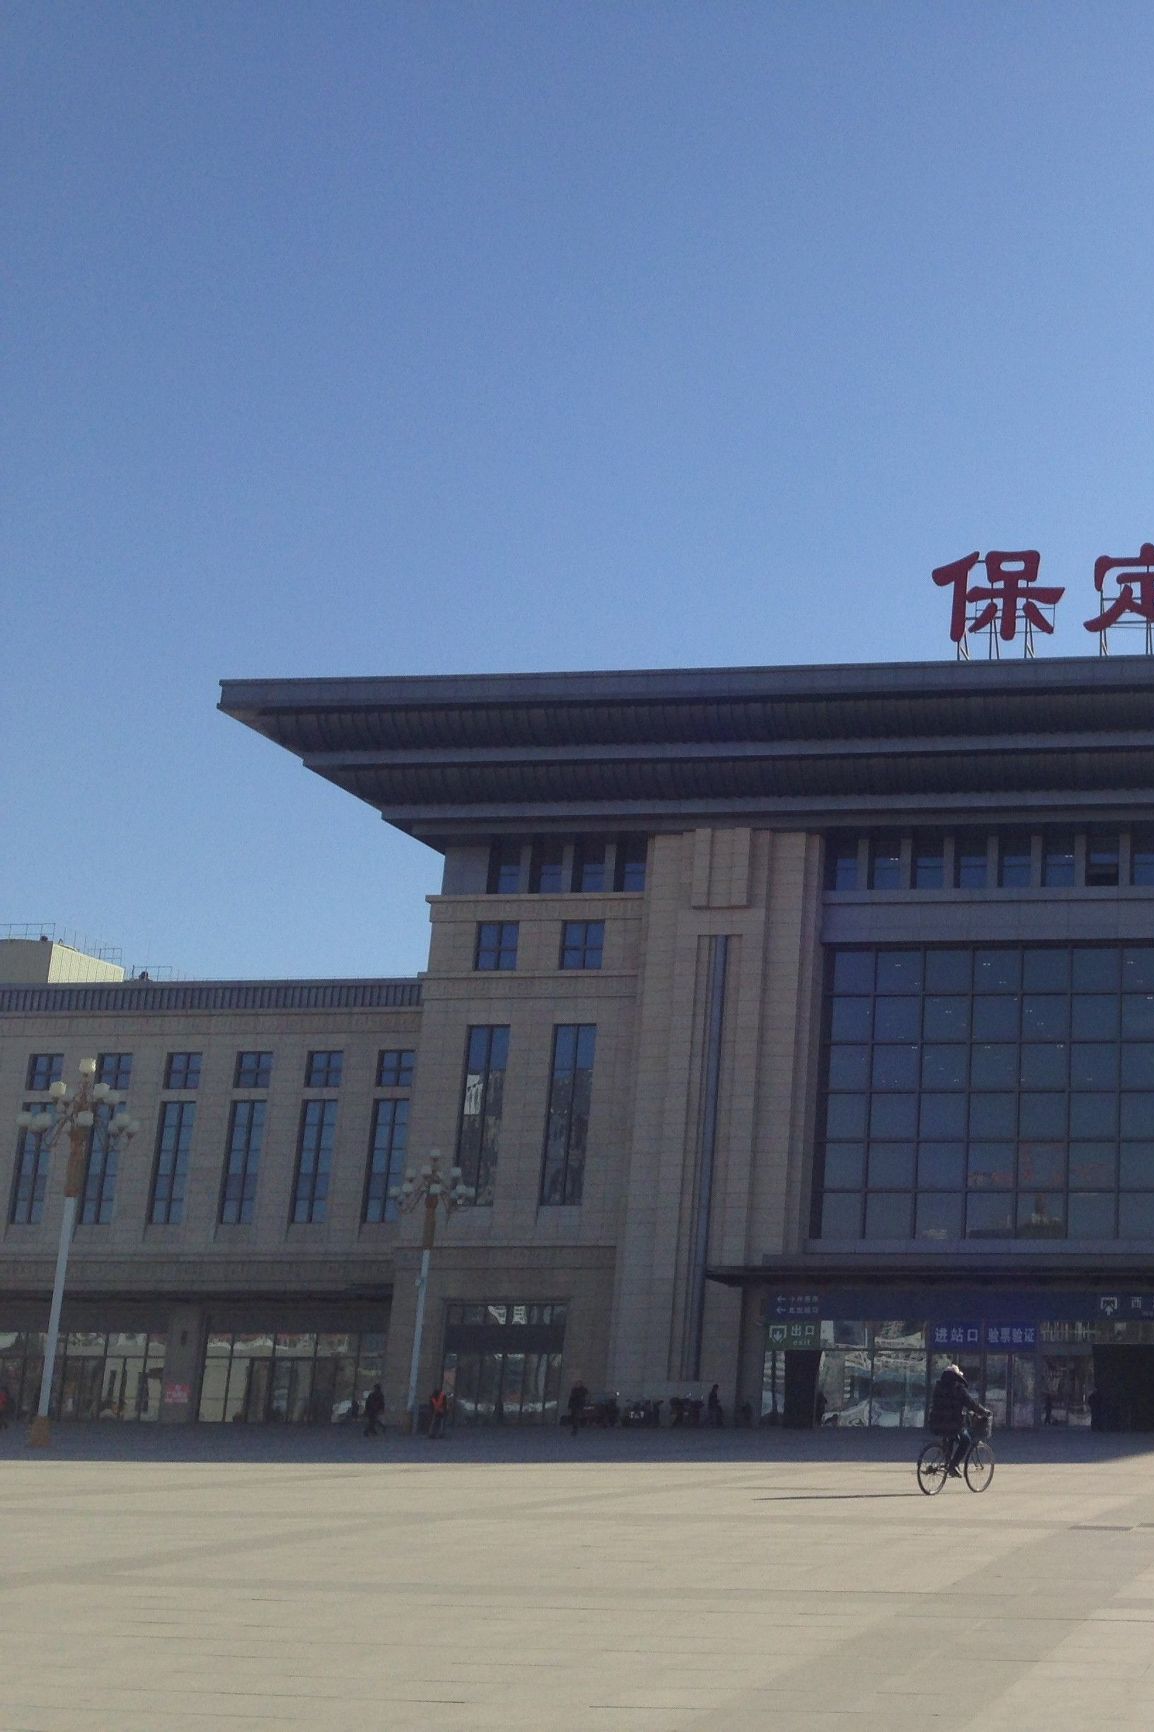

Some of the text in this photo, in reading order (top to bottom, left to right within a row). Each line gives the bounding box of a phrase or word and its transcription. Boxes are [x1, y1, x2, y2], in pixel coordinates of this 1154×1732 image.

[791, 1324, 815, 1336] 出口
[935, 1327, 1035, 1343] 进站口 验票验证
